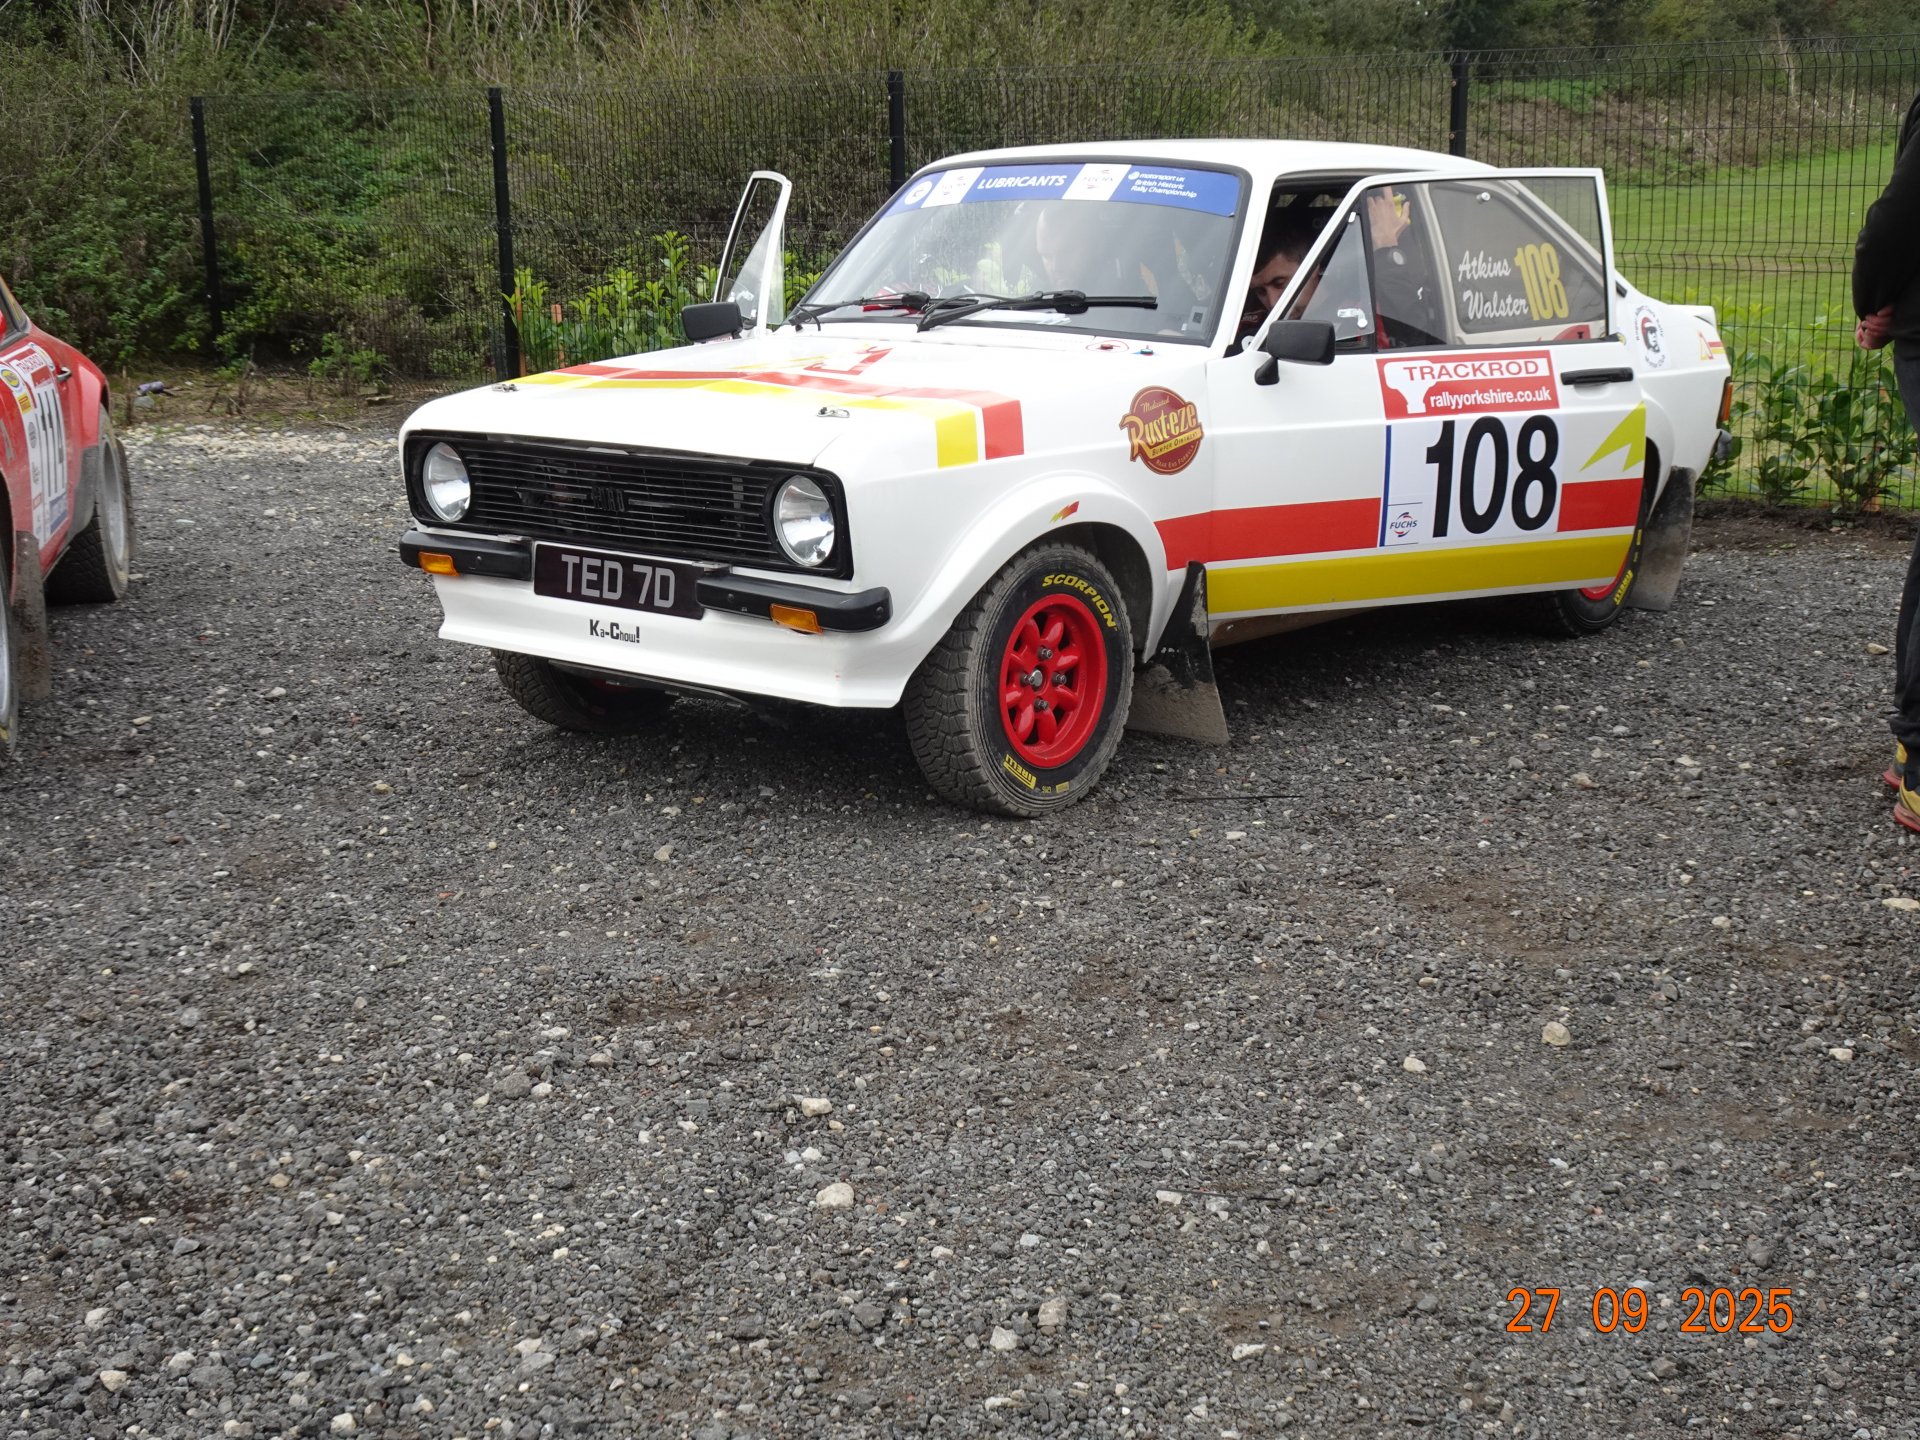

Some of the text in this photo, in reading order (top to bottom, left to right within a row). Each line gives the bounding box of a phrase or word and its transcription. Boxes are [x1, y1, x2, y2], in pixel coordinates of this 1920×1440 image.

[977, 175, 1067, 189] LUBRICANTS
[1135, 179, 1185, 190] British Historic
[1139, 173, 1176, 182] motorsport
[1131, 185, 1198, 199] Rally Championship
[1458, 250, 1512, 282] Atkins
[1514, 242, 1569, 321] 108
[1463, 290, 1529, 320] Walster
[1403, 360, 1539, 381] TRACKROD
[1430, 386, 1552, 410] rallyyorkshire.co.uk
[1425, 414, 1559, 538] 108
[1390, 520, 1418, 529] FUCHS
[561, 554, 676, 608] TED 7D
[1042, 574, 1117, 631] SCORPION
[589, 619, 640, 643] Ka-Chow!
[1004, 754, 1037, 790] PIRELLI
